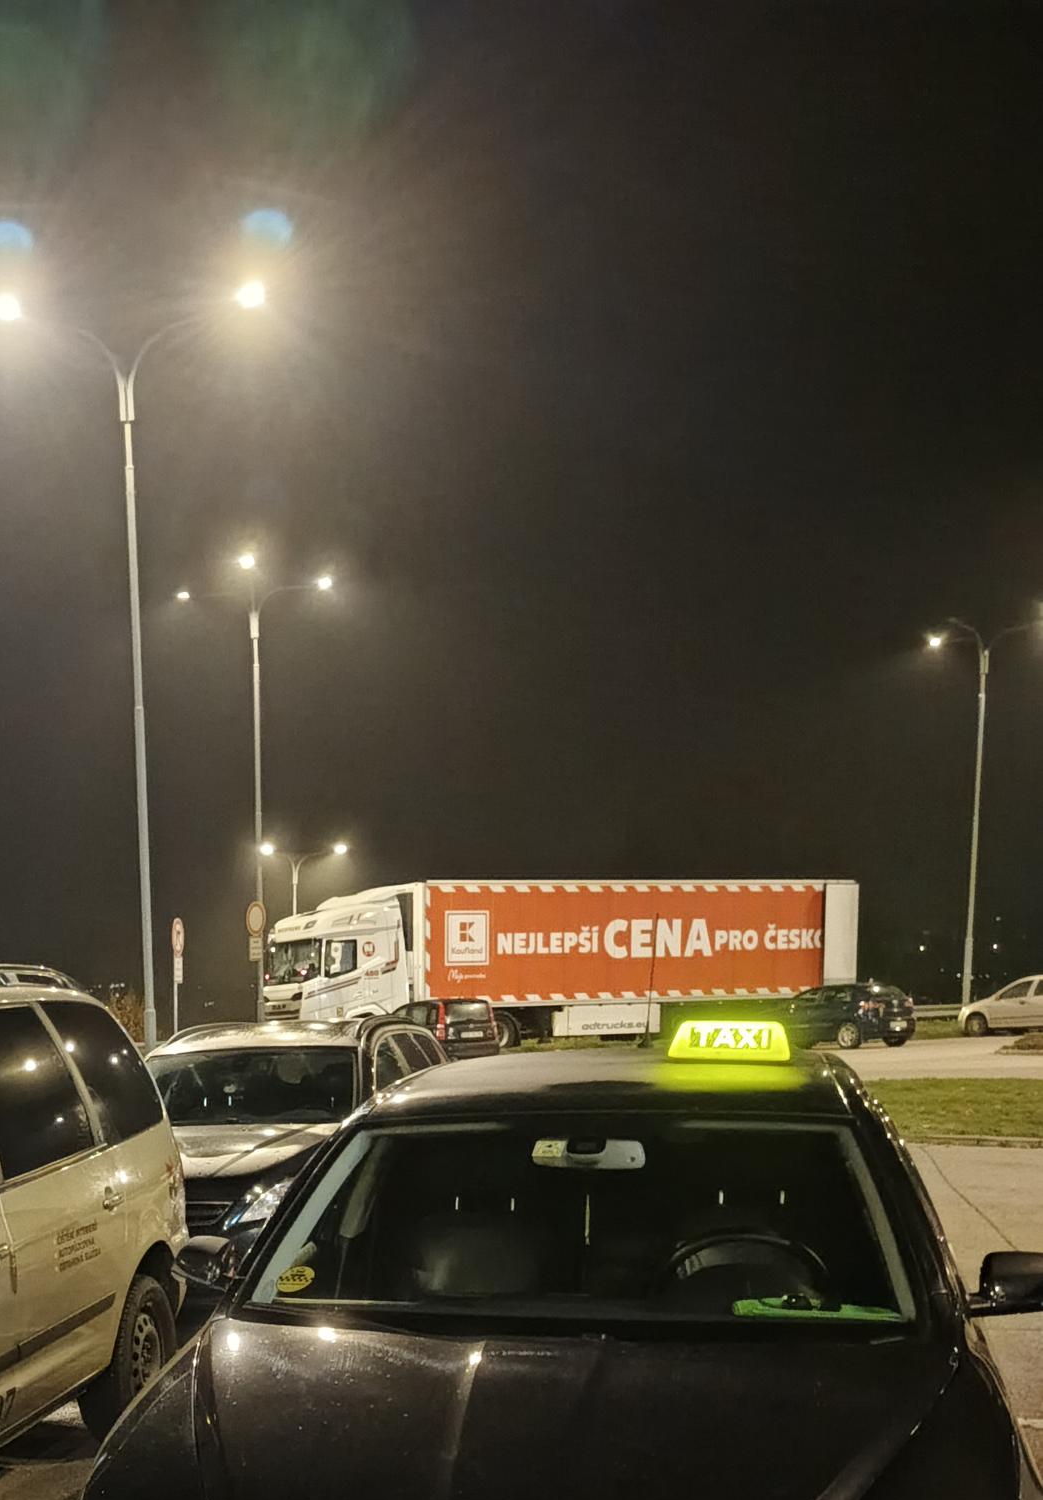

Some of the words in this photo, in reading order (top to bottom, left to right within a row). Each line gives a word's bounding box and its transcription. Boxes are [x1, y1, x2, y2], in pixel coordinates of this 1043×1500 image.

[451, 946, 484, 955] Kaufland
[497, 925, 599, 955] NEJLEPŠÍ
[603, 918, 713, 959] CENA
[714, 929, 758, 951] PRO
[693, 1026, 770, 1050] TAXI
